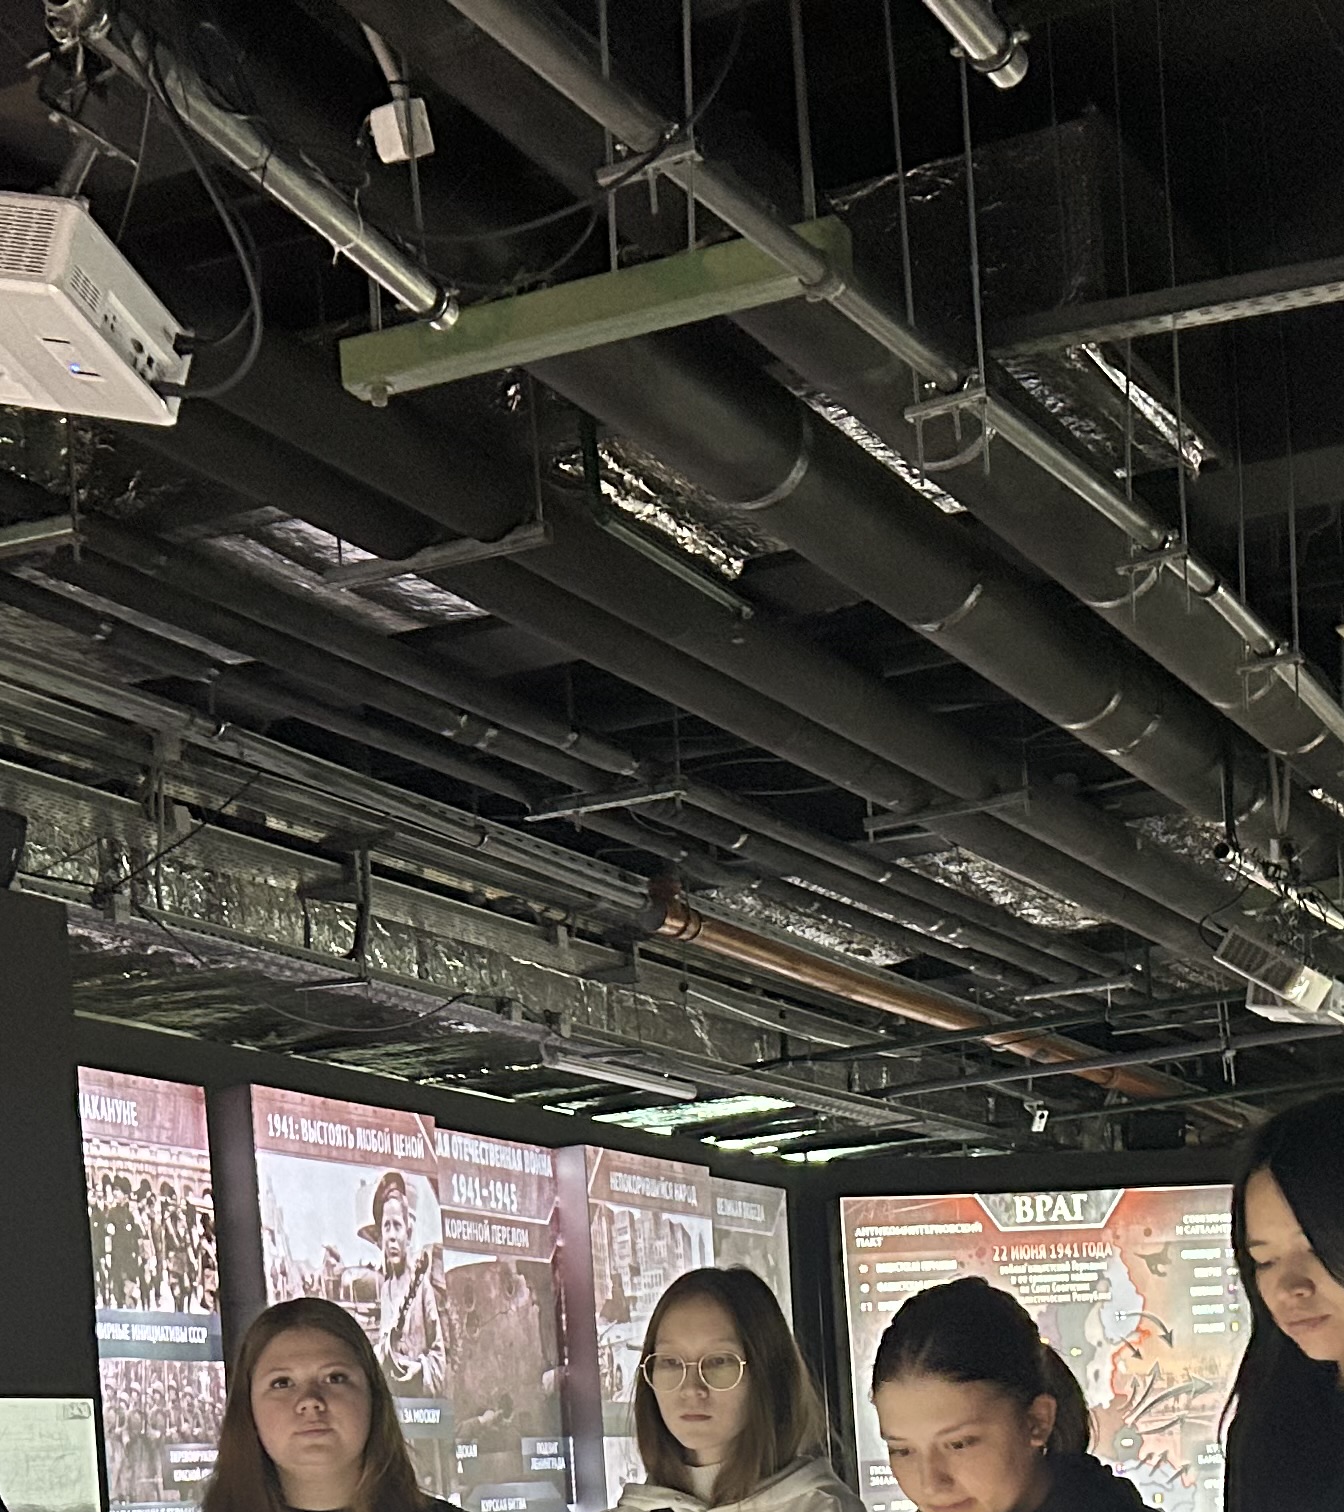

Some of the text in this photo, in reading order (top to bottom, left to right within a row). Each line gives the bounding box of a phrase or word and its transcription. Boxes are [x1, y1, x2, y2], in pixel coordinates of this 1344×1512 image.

[267, 1113, 425, 1159] 1941: ВЫСТОЯТЬ ЛЮБОЙ ЦЕНОЙ
[452, 1134, 523, 1171] ОТЕЧЕСТВЕННАЯ
[524, 1148, 553, 1178] ВОЙНА
[452, 1173, 517, 1213] 1941-1945
[1013, 1194, 1087, 1223] ВРАГ
[445, 1218, 529, 1248] КОРЕННОЙ ПЕРЕЛОМ
[993, 1242, 1112, 1261] 22 ИЮНЯ 1941 ГОДА
[131, 1323, 188, 1344] ИНИЦИАТИВЫ
[188, 1327, 208, 1344] СССР
[413, 1408, 440, 1423] МОСКВУ
[481, 1499, 507, 1512] КУРСКАЯ
